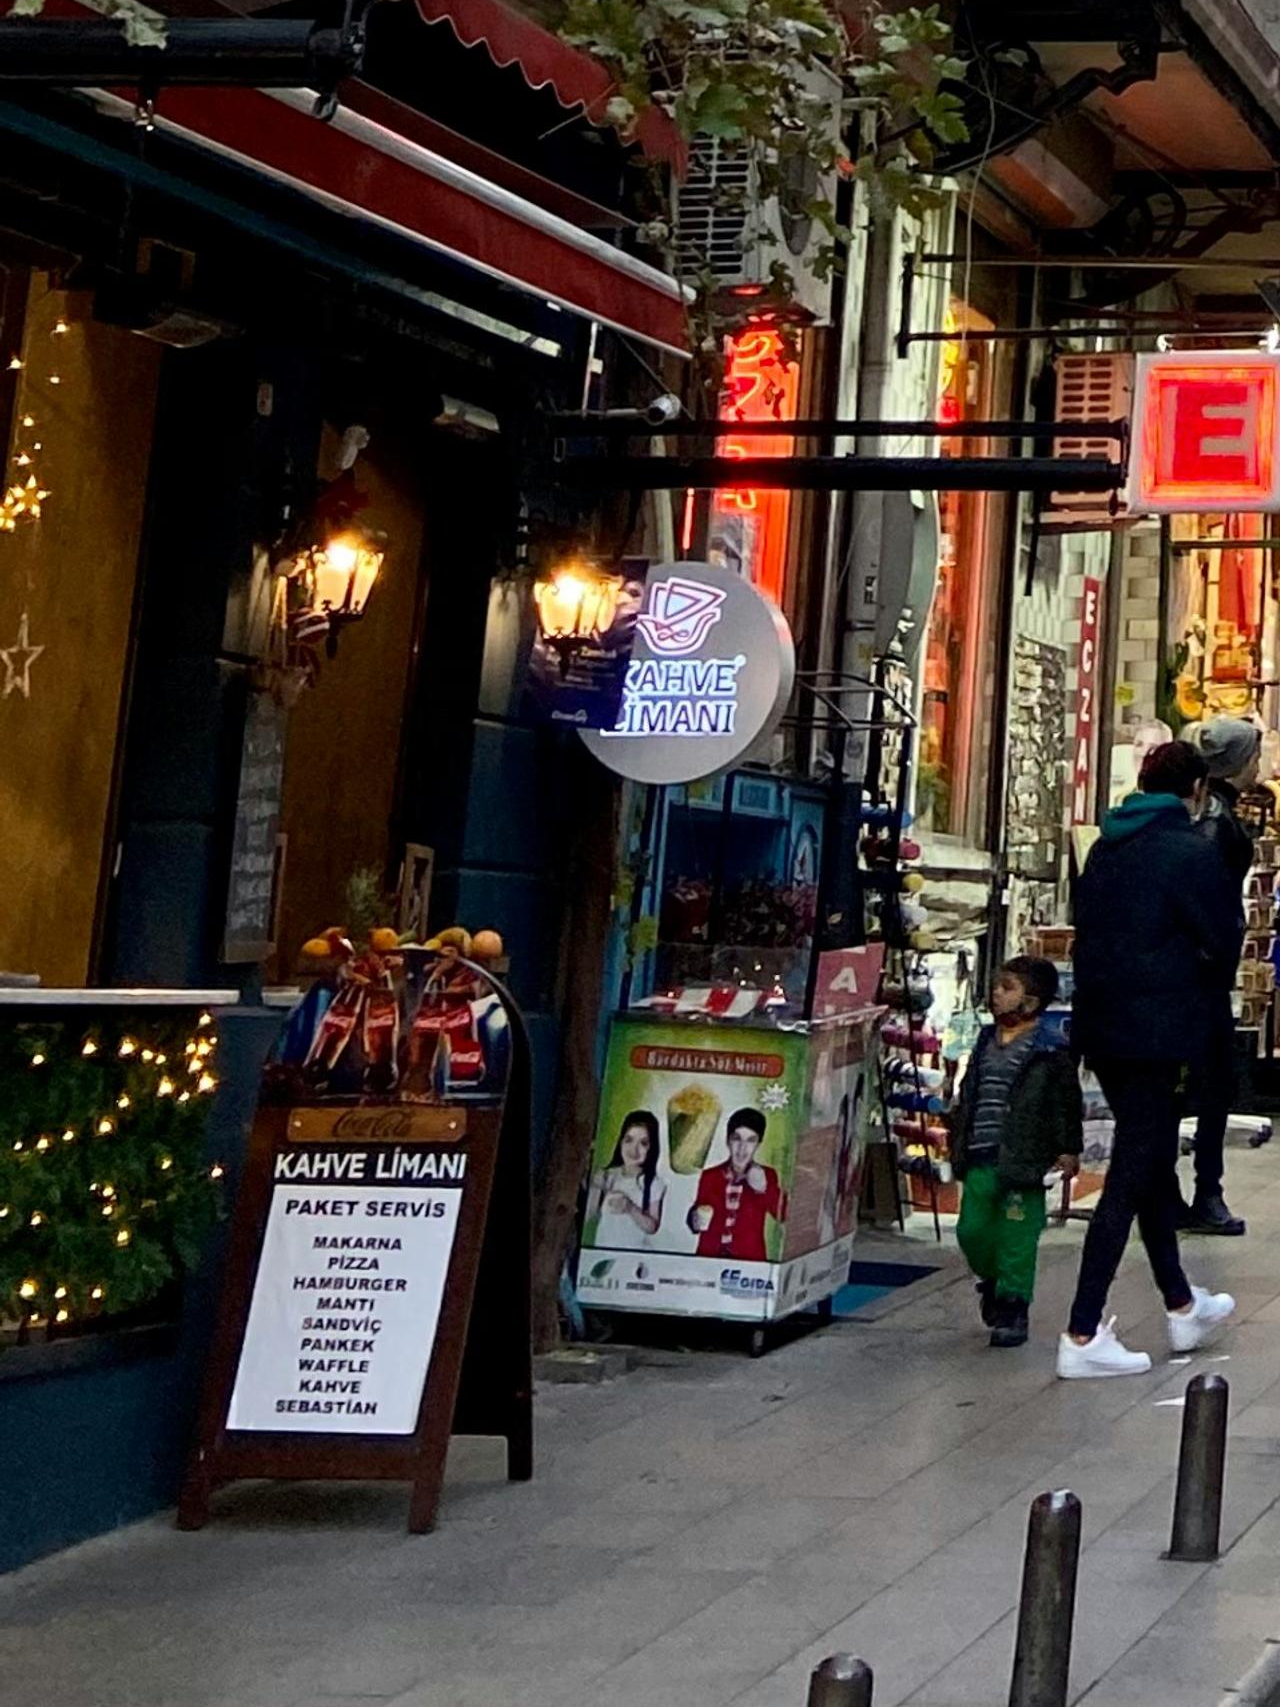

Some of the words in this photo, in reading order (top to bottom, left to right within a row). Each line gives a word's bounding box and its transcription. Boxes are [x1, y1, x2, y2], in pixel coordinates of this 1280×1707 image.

[1172, 382, 1249, 481] E
[600, 697, 737, 736] İMANI
[273, 1153, 368, 1179] KAHVE
[374, 1146, 468, 1180] LİMANI
[284, 1199, 359, 1217] PAKET
[364, 1198, 447, 1219] SERVİS
[312, 1236, 402, 1251] MAKARNA
[327, 1255, 380, 1271] PİZZA
[292, 1276, 408, 1292] HAMBURGER
[316, 1297, 376, 1312] MANTI
[301, 1316, 383, 1336] SANDVİÇ
[300, 1338, 376, 1353] PANKEK
[298, 1358, 370, 1374] WAFFLE
[298, 1379, 362, 1395] KAHVE
[274, 1399, 378, 1415] SEBASTİAN
